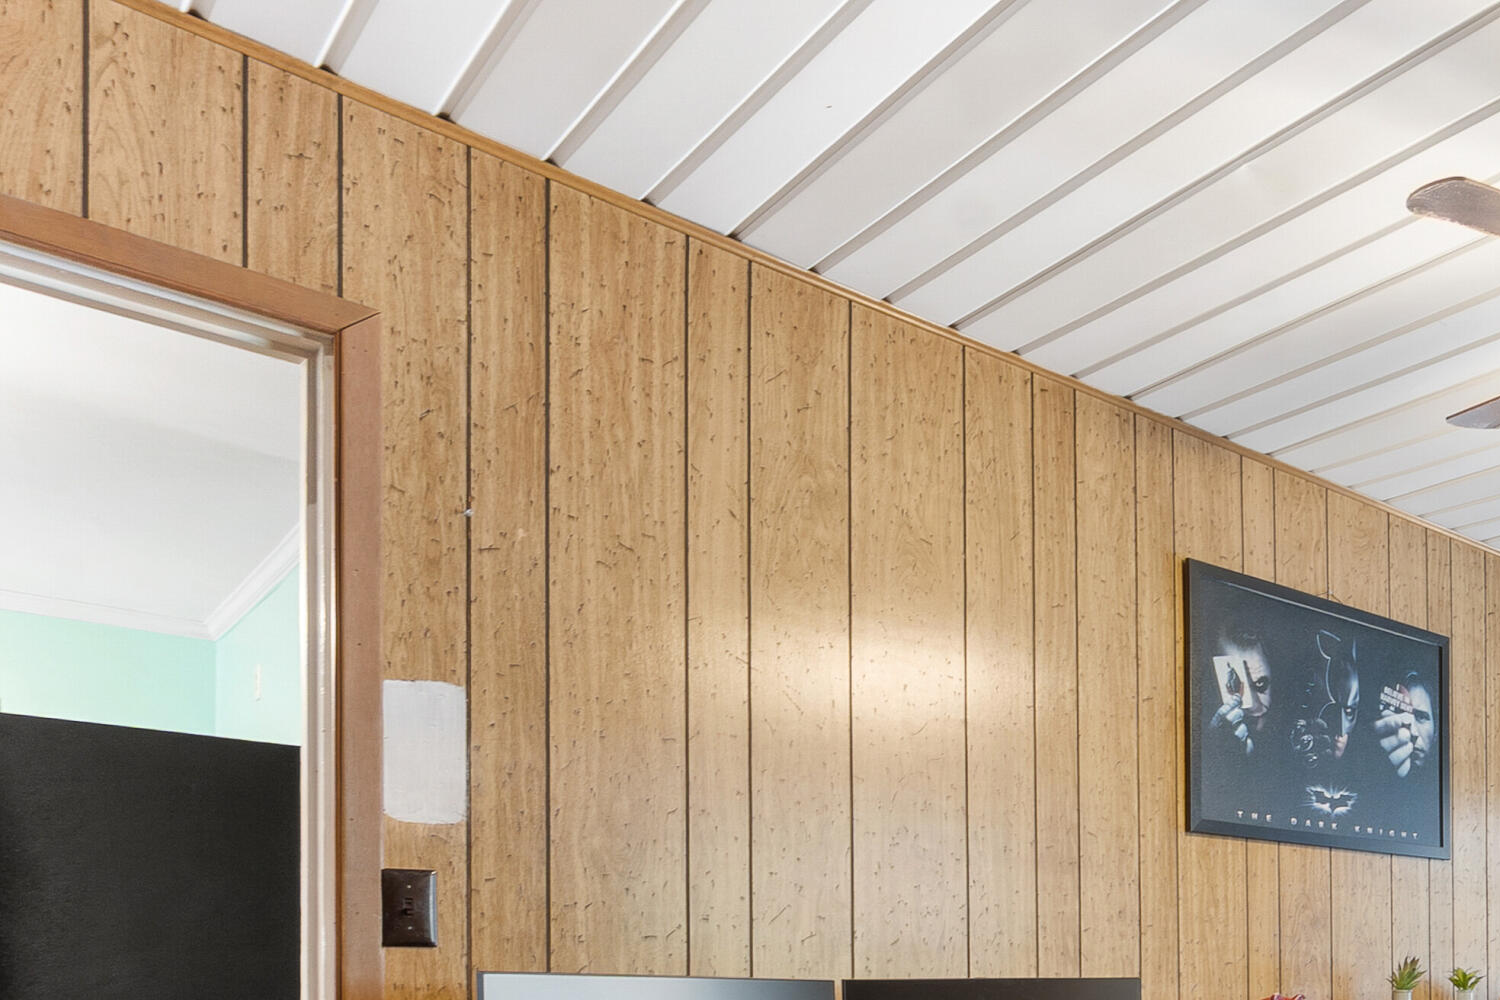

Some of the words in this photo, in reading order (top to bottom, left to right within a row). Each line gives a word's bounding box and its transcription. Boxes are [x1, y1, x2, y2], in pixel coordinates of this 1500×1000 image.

[1237, 810, 1272, 823] THE
[1290, 817, 1338, 831] DARK
[1354, 825, 1418, 840] KNIGHT
